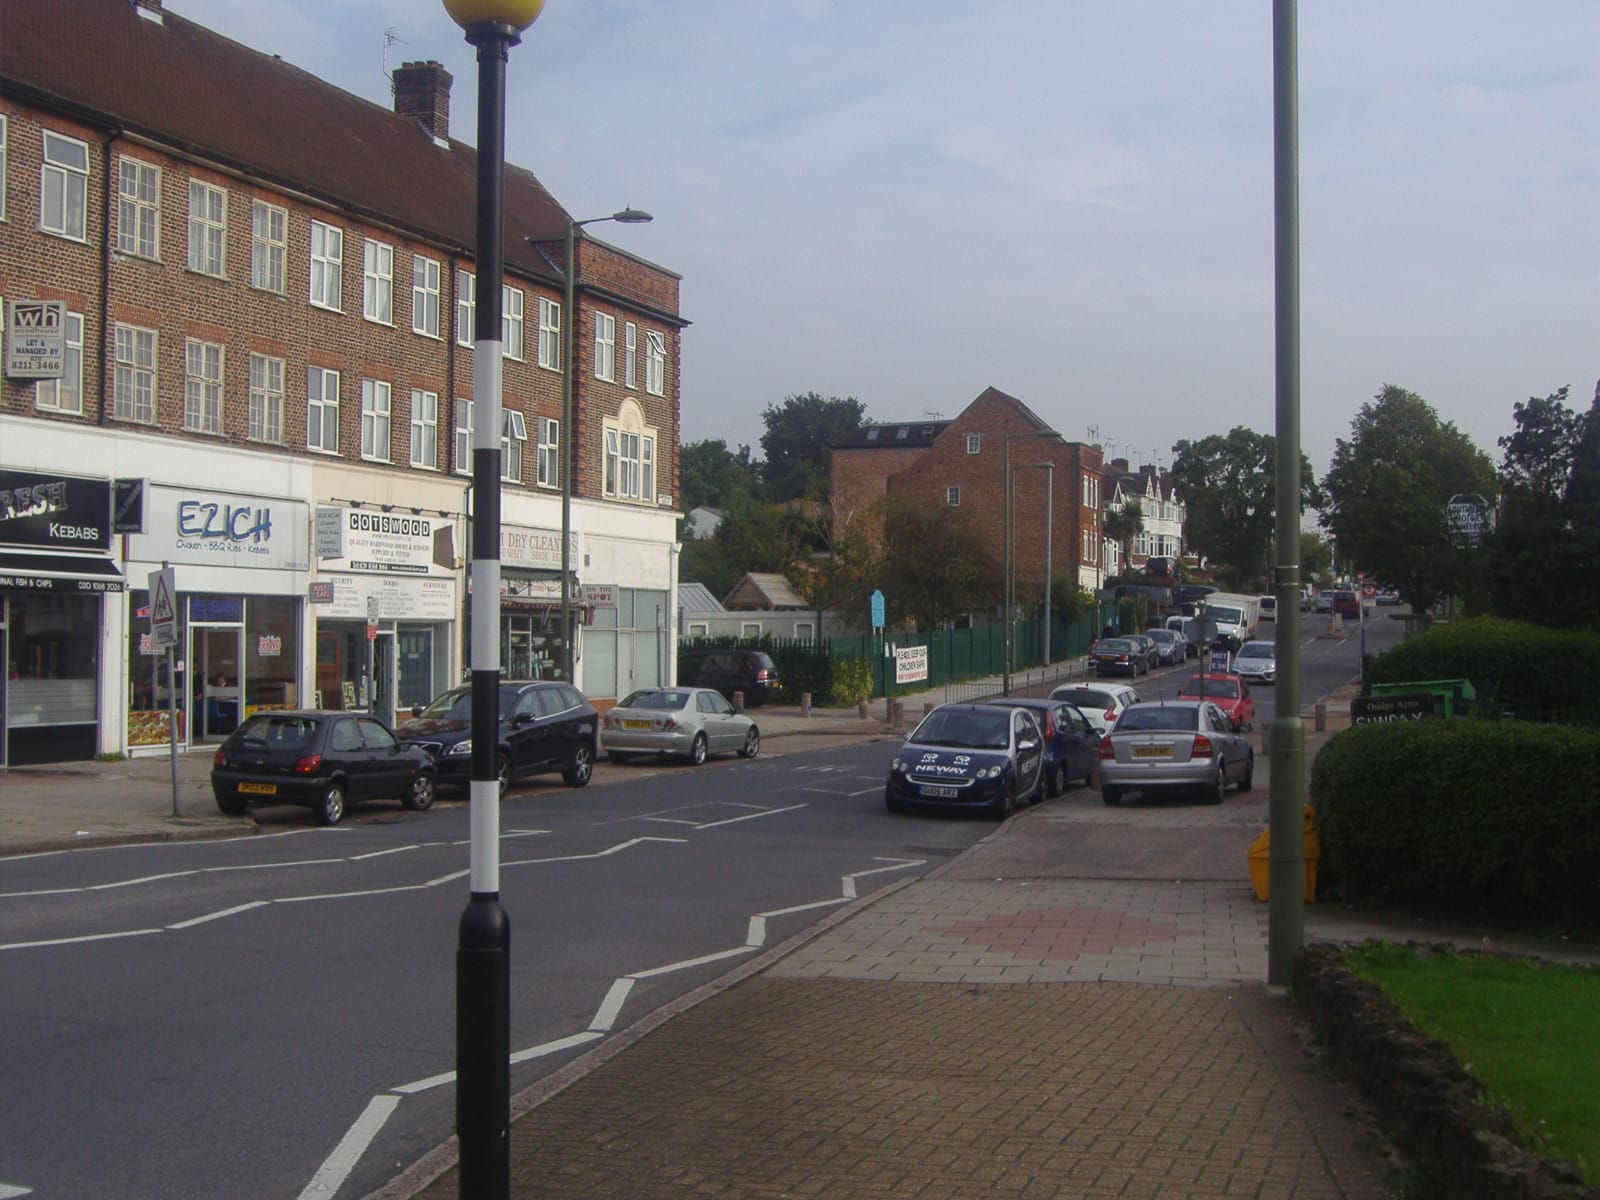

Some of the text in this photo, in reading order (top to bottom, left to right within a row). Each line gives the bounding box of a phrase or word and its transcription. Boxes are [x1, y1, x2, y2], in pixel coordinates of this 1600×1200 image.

[15, 347, 59, 356] MANAGED BY
[11, 361, 60, 370] 8211 3466
[176, 500, 272, 544] EZICH
[350, 513, 430, 537] COTSWOOD
[508, 532, 528, 549] DRY
[529, 535, 578, 552] CLEANS
[532, 550, 549, 561] SHOE
[15, 577, 28, 586] FISH
[35, 579, 53, 588] CHIPS
[915, 764, 968, 775] NEWAY
